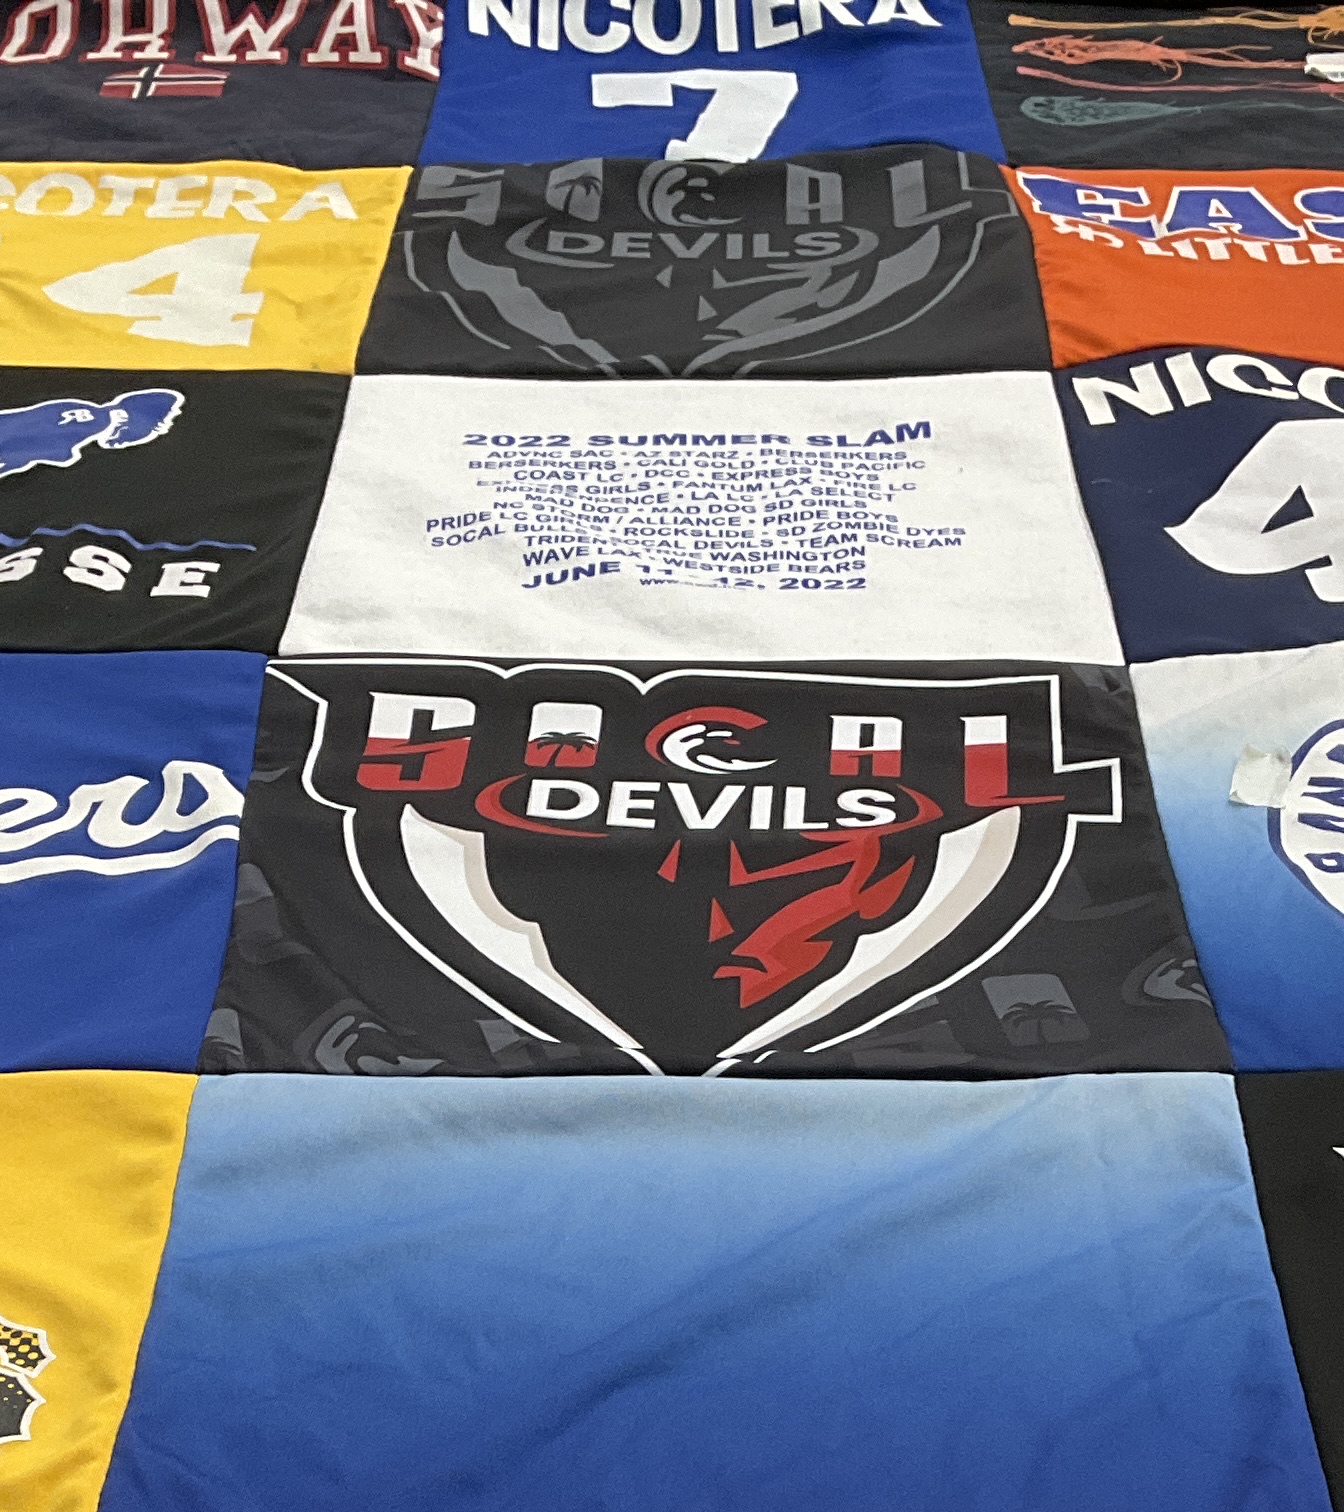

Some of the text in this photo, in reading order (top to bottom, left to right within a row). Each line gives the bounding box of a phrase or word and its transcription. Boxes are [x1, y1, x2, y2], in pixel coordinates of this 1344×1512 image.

[592, 69, 798, 163] 7
[547, 231, 843, 259] DEVILS
[462, 421, 931, 447] 2022 SUMMER SLAM
[468, 458, 926, 471] BERSERKERS CALI GOLD CLUB PACIFIC
[487, 450, 562, 458] ADVNC
[570, 449, 613, 458] SAC
[760, 448, 906, 460] BERSERKERS
[513, 466, 879, 482] COAST LC DCC EXPRESS BOYS
[585, 482, 651, 494] GIRLS
[673, 480, 762, 492] FANTUM
[770, 476, 812, 489] LAX
[889, 482, 916, 491] LC
[525, 493, 867, 514] MAD DOG MAD DOG SD GIRLS
[691, 491, 719, 500] LA
[726, 493, 754, 502] LC
[775, 489, 803, 498] LA
[811, 486, 895, 501] SELECT
[427, 511, 492, 532] PRIDE
[500, 512, 528, 520] LC
[624, 527, 754, 538] ROCKSLIDE
[777, 526, 806, 537] SD
[812, 521, 899, 534] ZOMBIE
[906, 527, 966, 536] DYES
[494, 502, 524, 510] NC
[629, 516, 741, 526] ALLIANCE
[763, 510, 829, 526] PRIDE
[837, 511, 898, 522] BOYS
[431, 524, 506, 547] SOCAL
[514, 524, 587, 534] BULLS
[694, 539, 774, 550] DEVILS
[796, 533, 858, 548] TEAM
[866, 534, 962, 548] SCREAM
[523, 546, 866, 574] WAVE LAX WESTSIDE BEARS
[710, 546, 865, 561] WASHINGTON
[521, 561, 621, 588] JUNE
[779, 578, 866, 589] 2022
[527, 779, 898, 832] DEVILS
